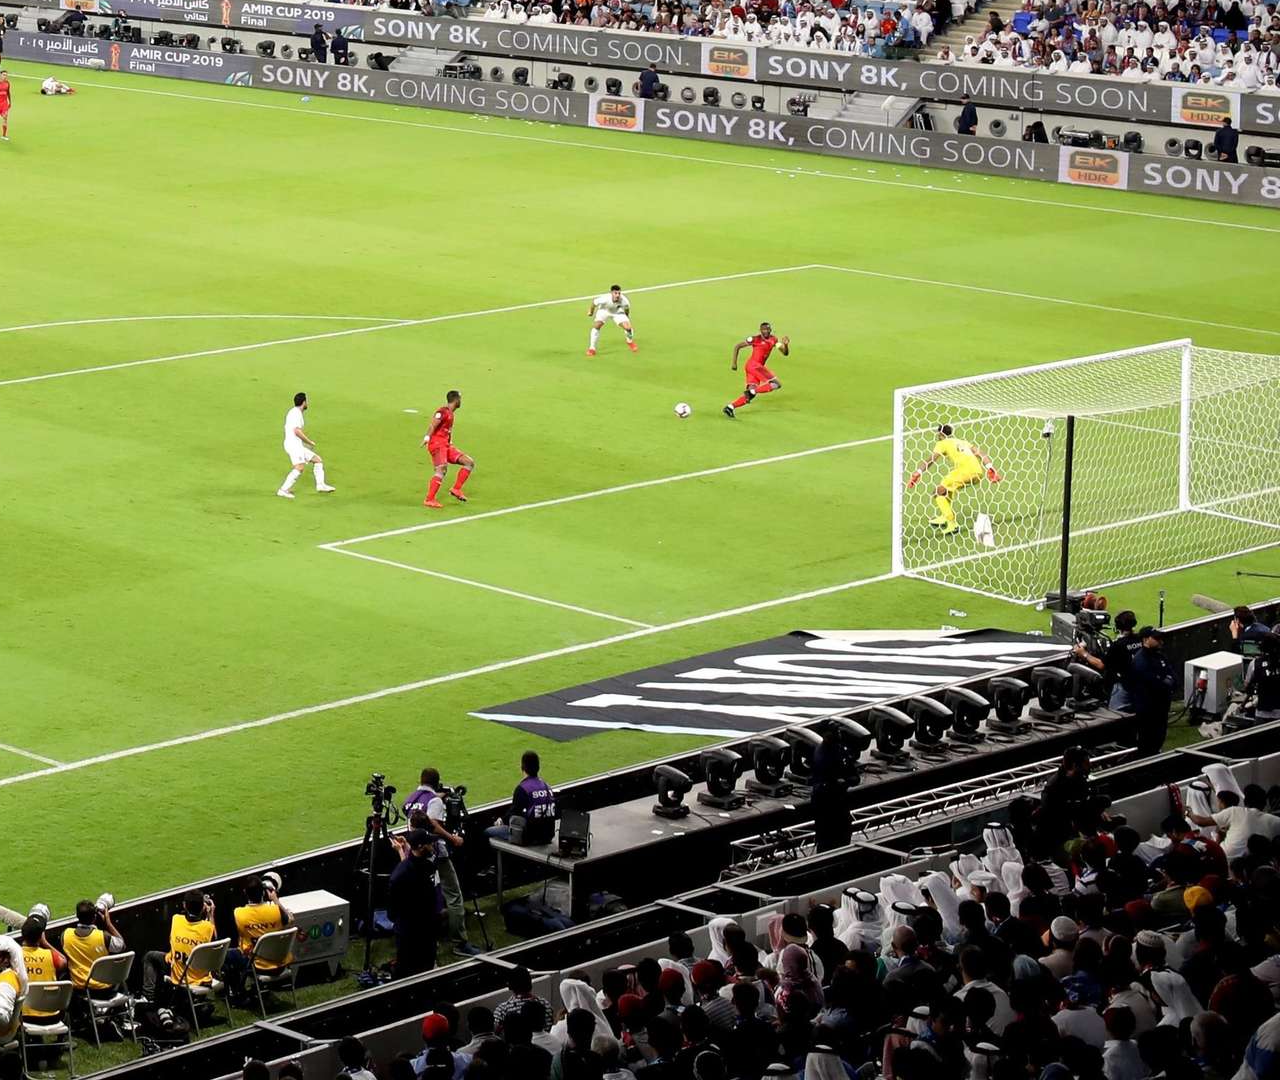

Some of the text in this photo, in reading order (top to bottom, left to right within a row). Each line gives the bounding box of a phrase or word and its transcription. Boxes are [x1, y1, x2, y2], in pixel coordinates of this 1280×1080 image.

[240, 16, 266, 27] Final
[242, 4, 334, 22] AMIR CUP 2019
[130, 48, 223, 67] AMIR CUP 2019
[374, 16, 690, 66] SONY 8K, COMING SOON.
[130, 60, 155, 72] Final
[262, 64, 577, 118] SONY 8K, COMING SOON.
[768, 56, 1156, 113] SONY 8K, COMING SOON.
[656, 108, 1045, 174] SONY 8K, COMING SOON.
[1144, 162, 1248, 196] SONY
